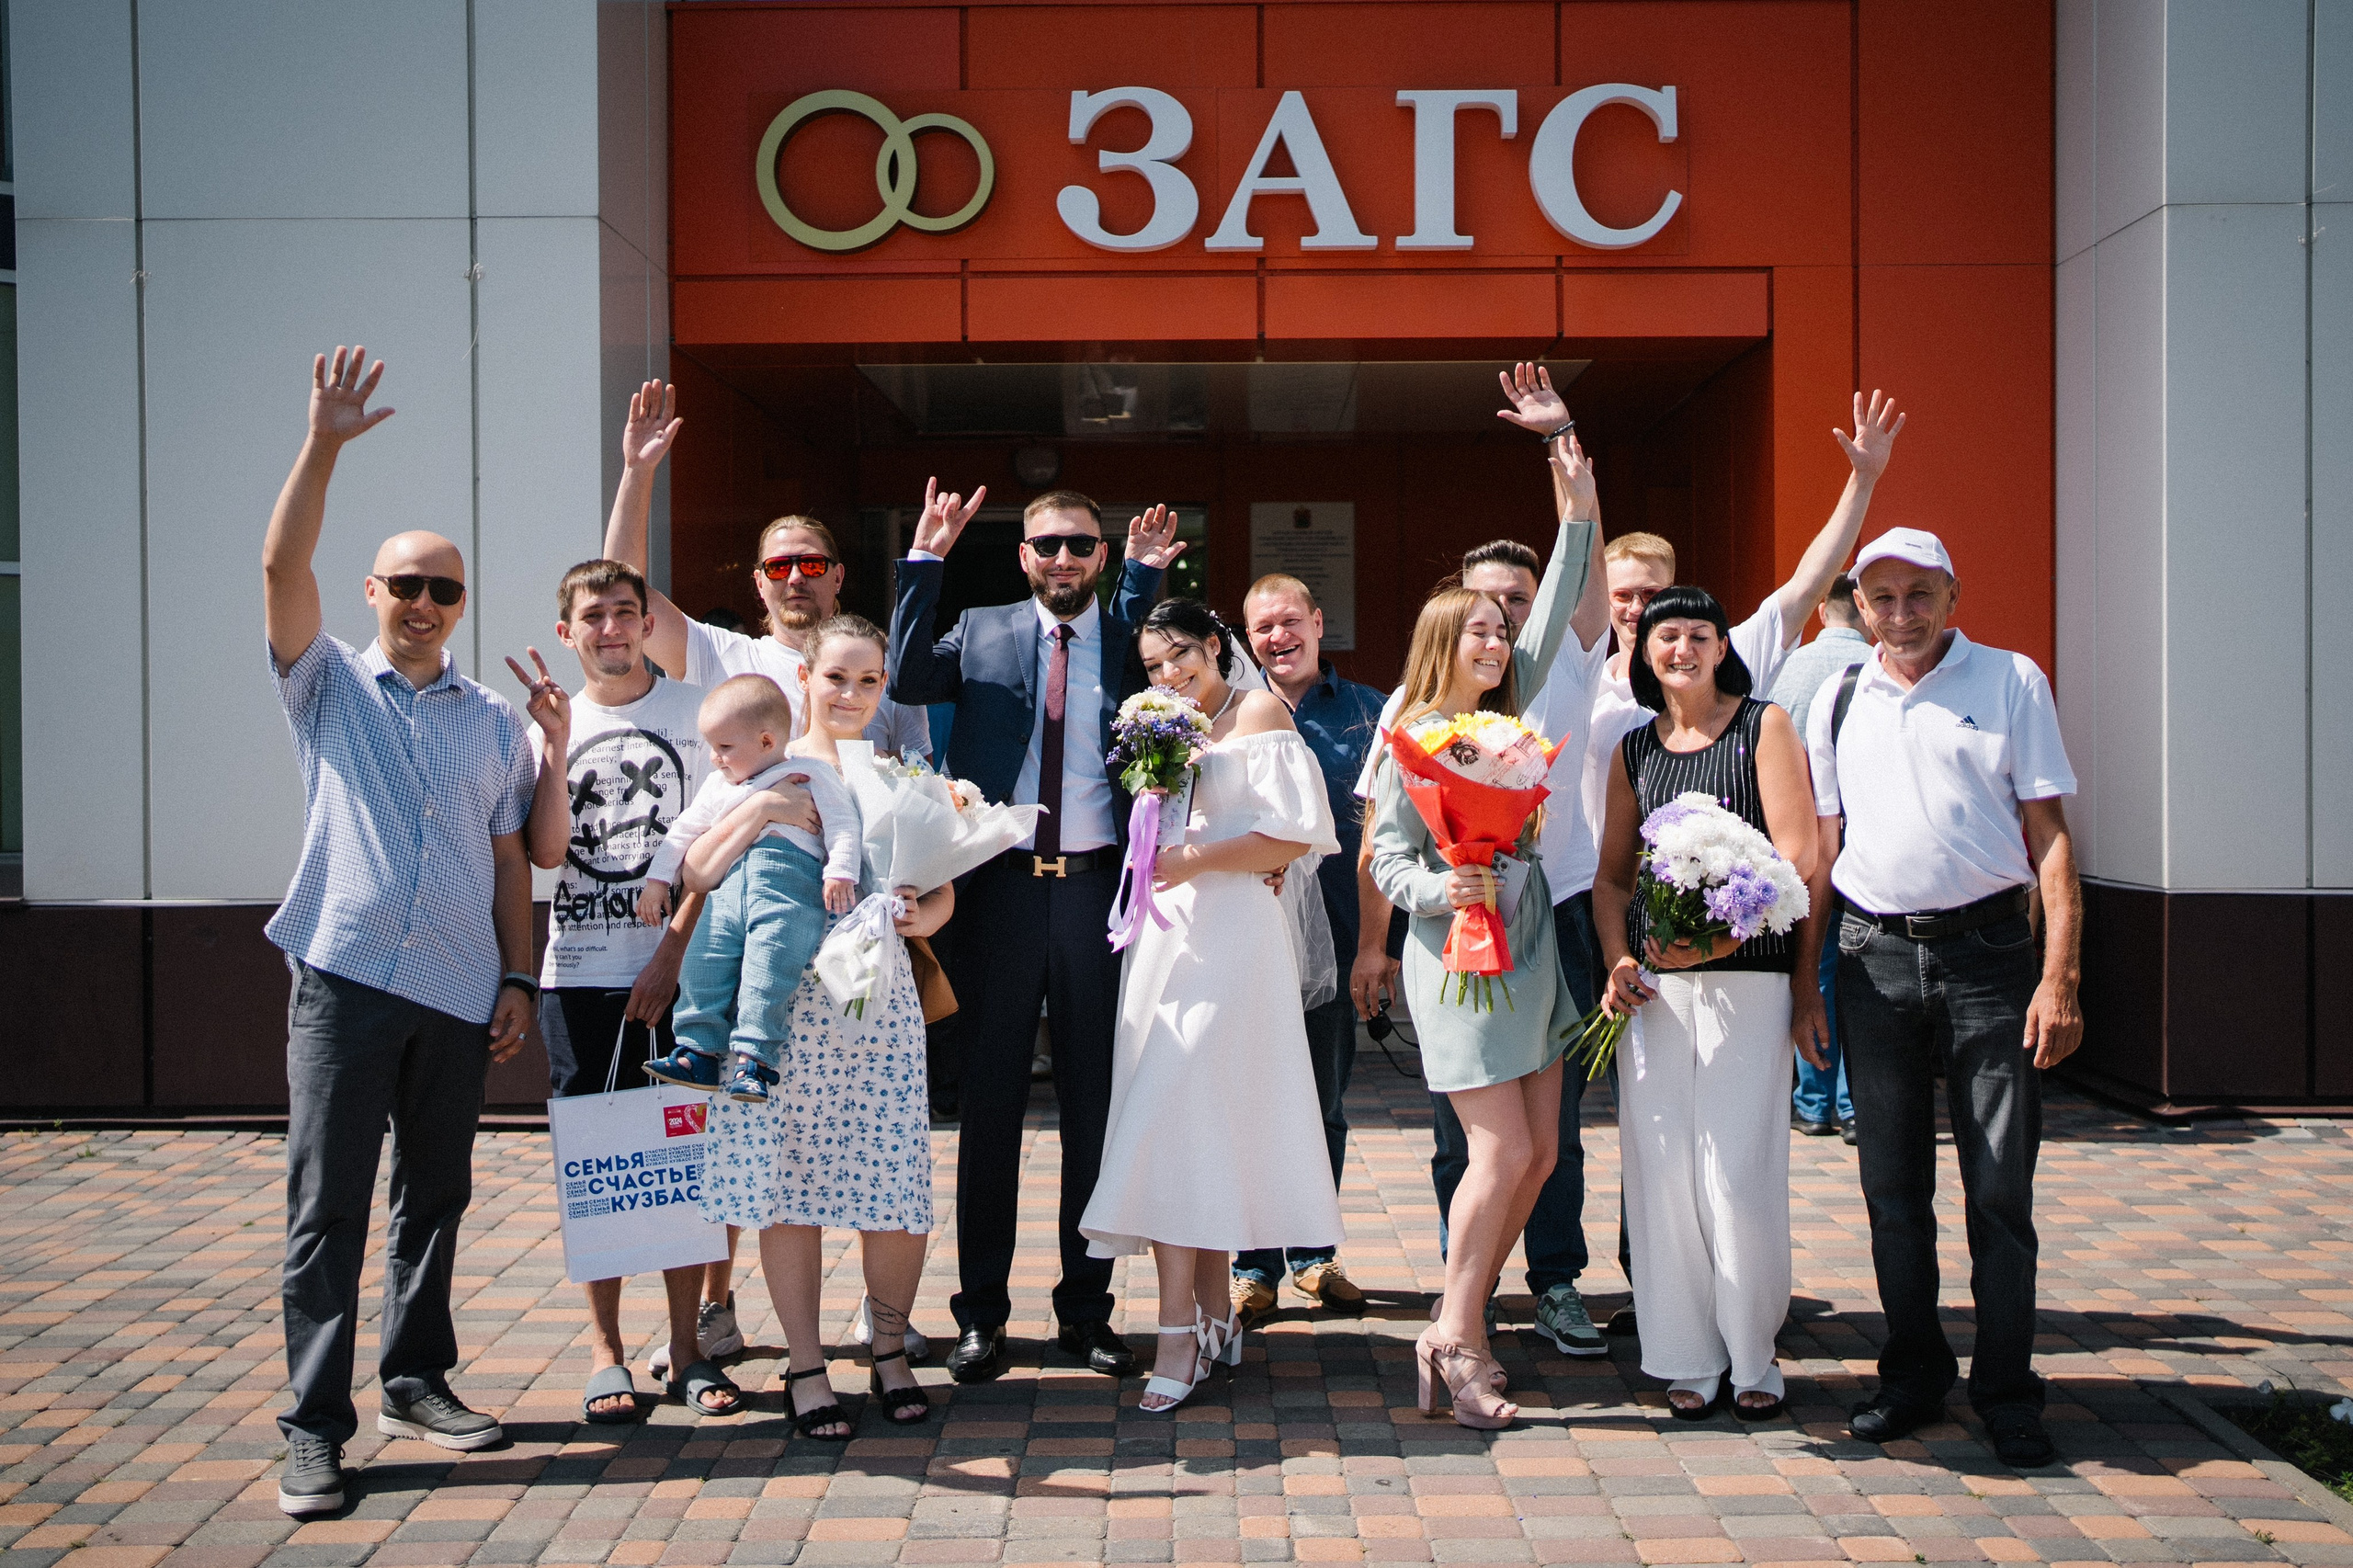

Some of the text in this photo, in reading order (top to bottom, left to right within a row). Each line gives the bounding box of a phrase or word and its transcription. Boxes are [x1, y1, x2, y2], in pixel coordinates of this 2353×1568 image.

[1057, 83, 1682, 253] ЗАГС
[1956, 722, 1979, 731] adidas
[591, 744, 624, 754] earnest
[574, 756, 618, 767] sincerely;
[572, 825, 580, 834] to
[568, 922, 604, 931] attention
[564, 1152, 644, 1178] СЕМЬЯ
[588, 1165, 698, 1195] СЧАСТЬЕ
